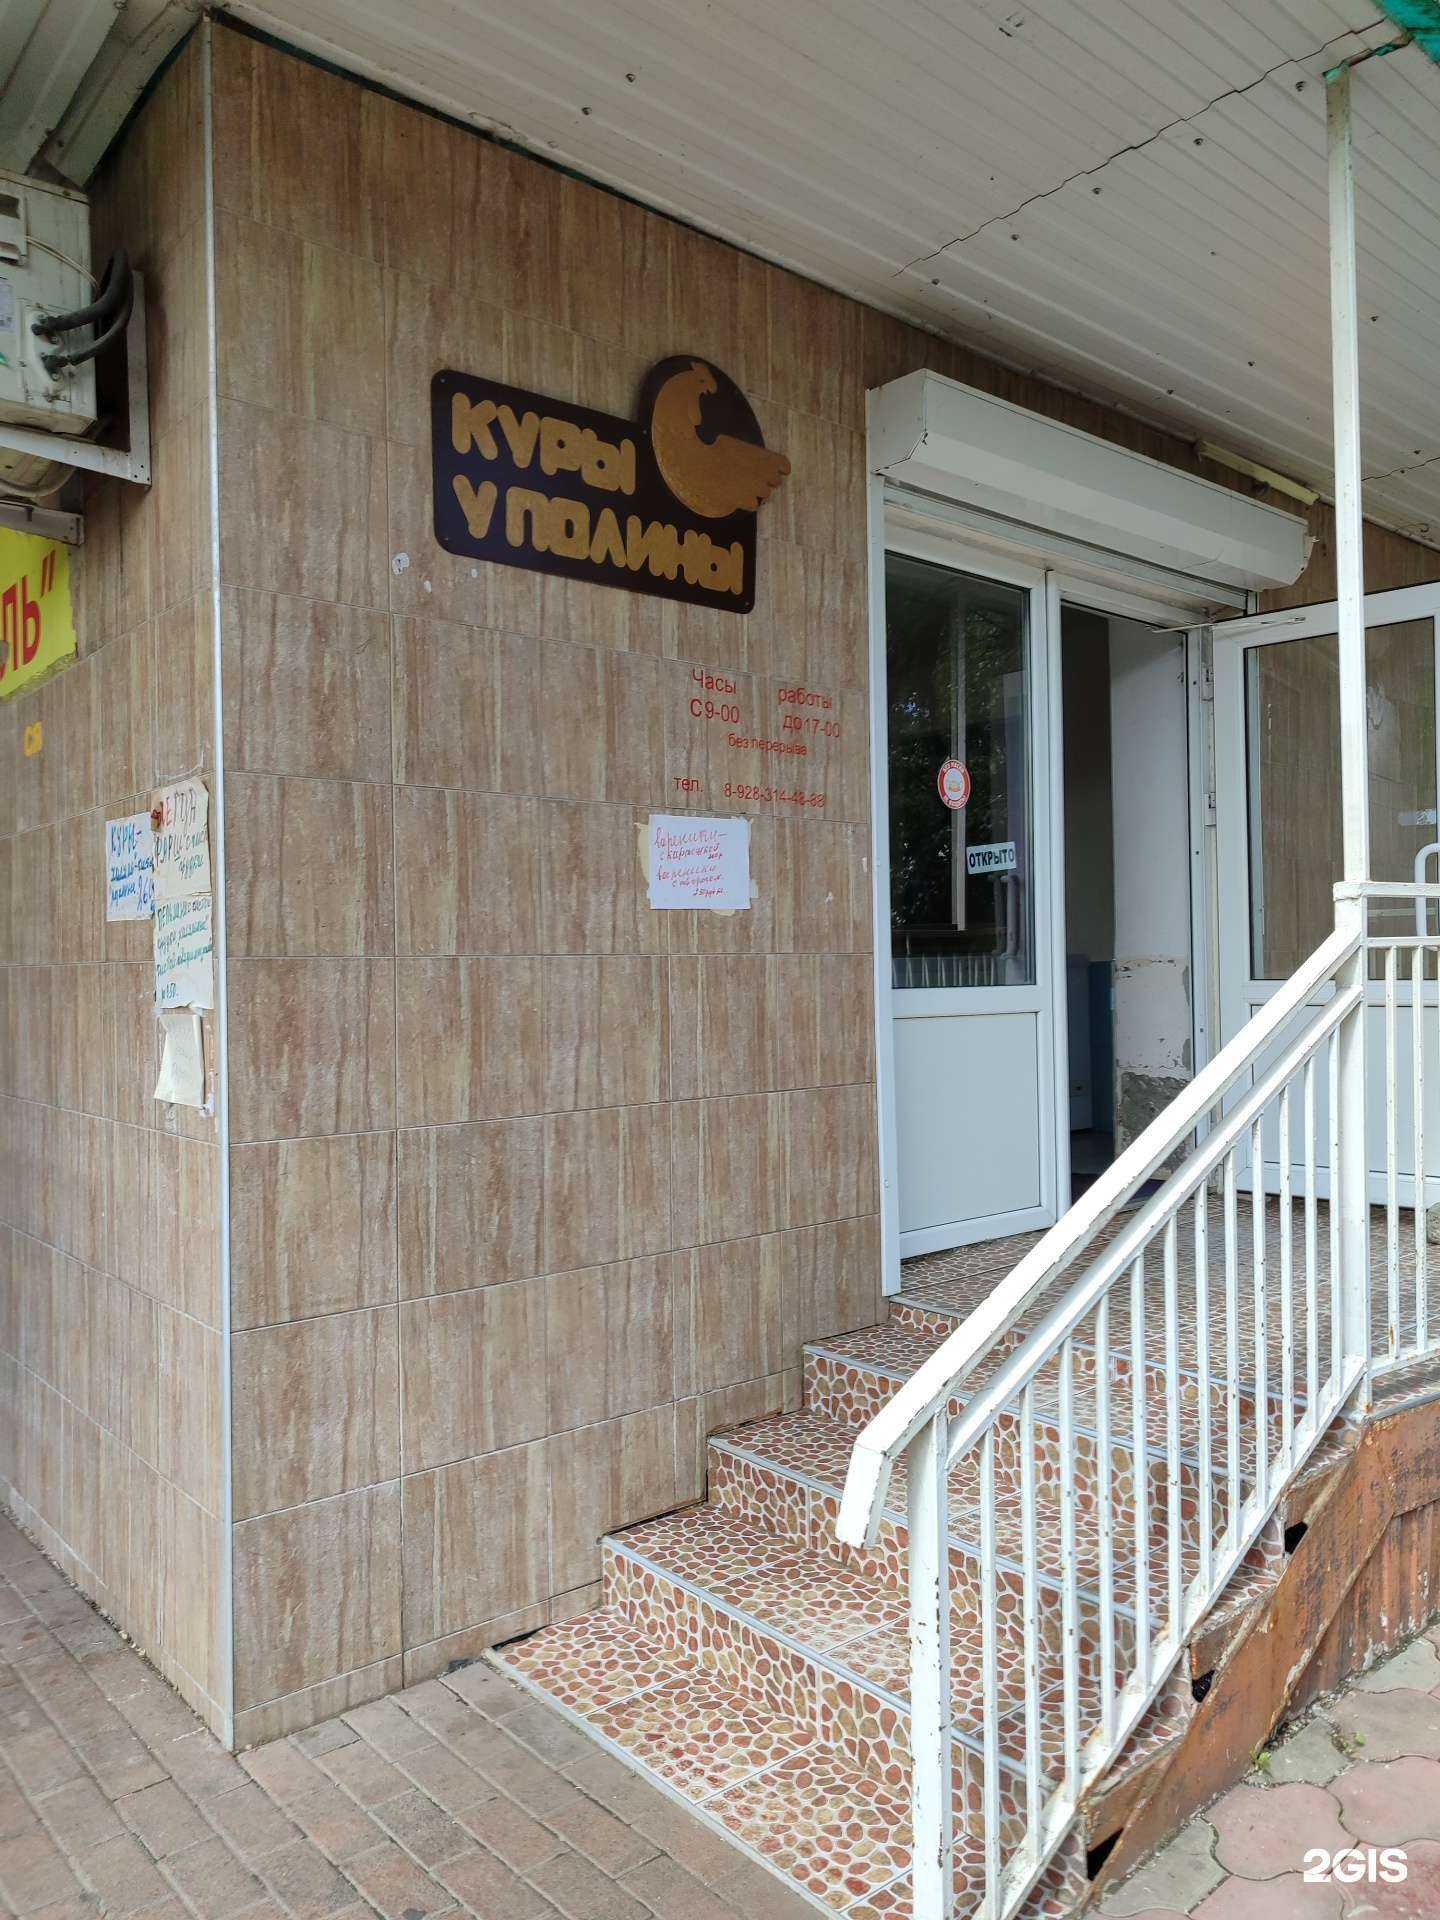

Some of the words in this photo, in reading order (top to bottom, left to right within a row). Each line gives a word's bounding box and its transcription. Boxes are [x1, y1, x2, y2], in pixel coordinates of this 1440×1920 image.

[452, 393, 636, 495] КУРЫ
[452, 475, 498, 539] У
[506, 487, 745, 595] ПОЛИНЫ
[692, 669, 737, 694] Часы
[778, 688, 832, 710] работы
[751, 736, 808, 756] перерыва
[674, 776, 703, 792] тел.
[969, 849, 1015, 868] ОТКРЫТО
